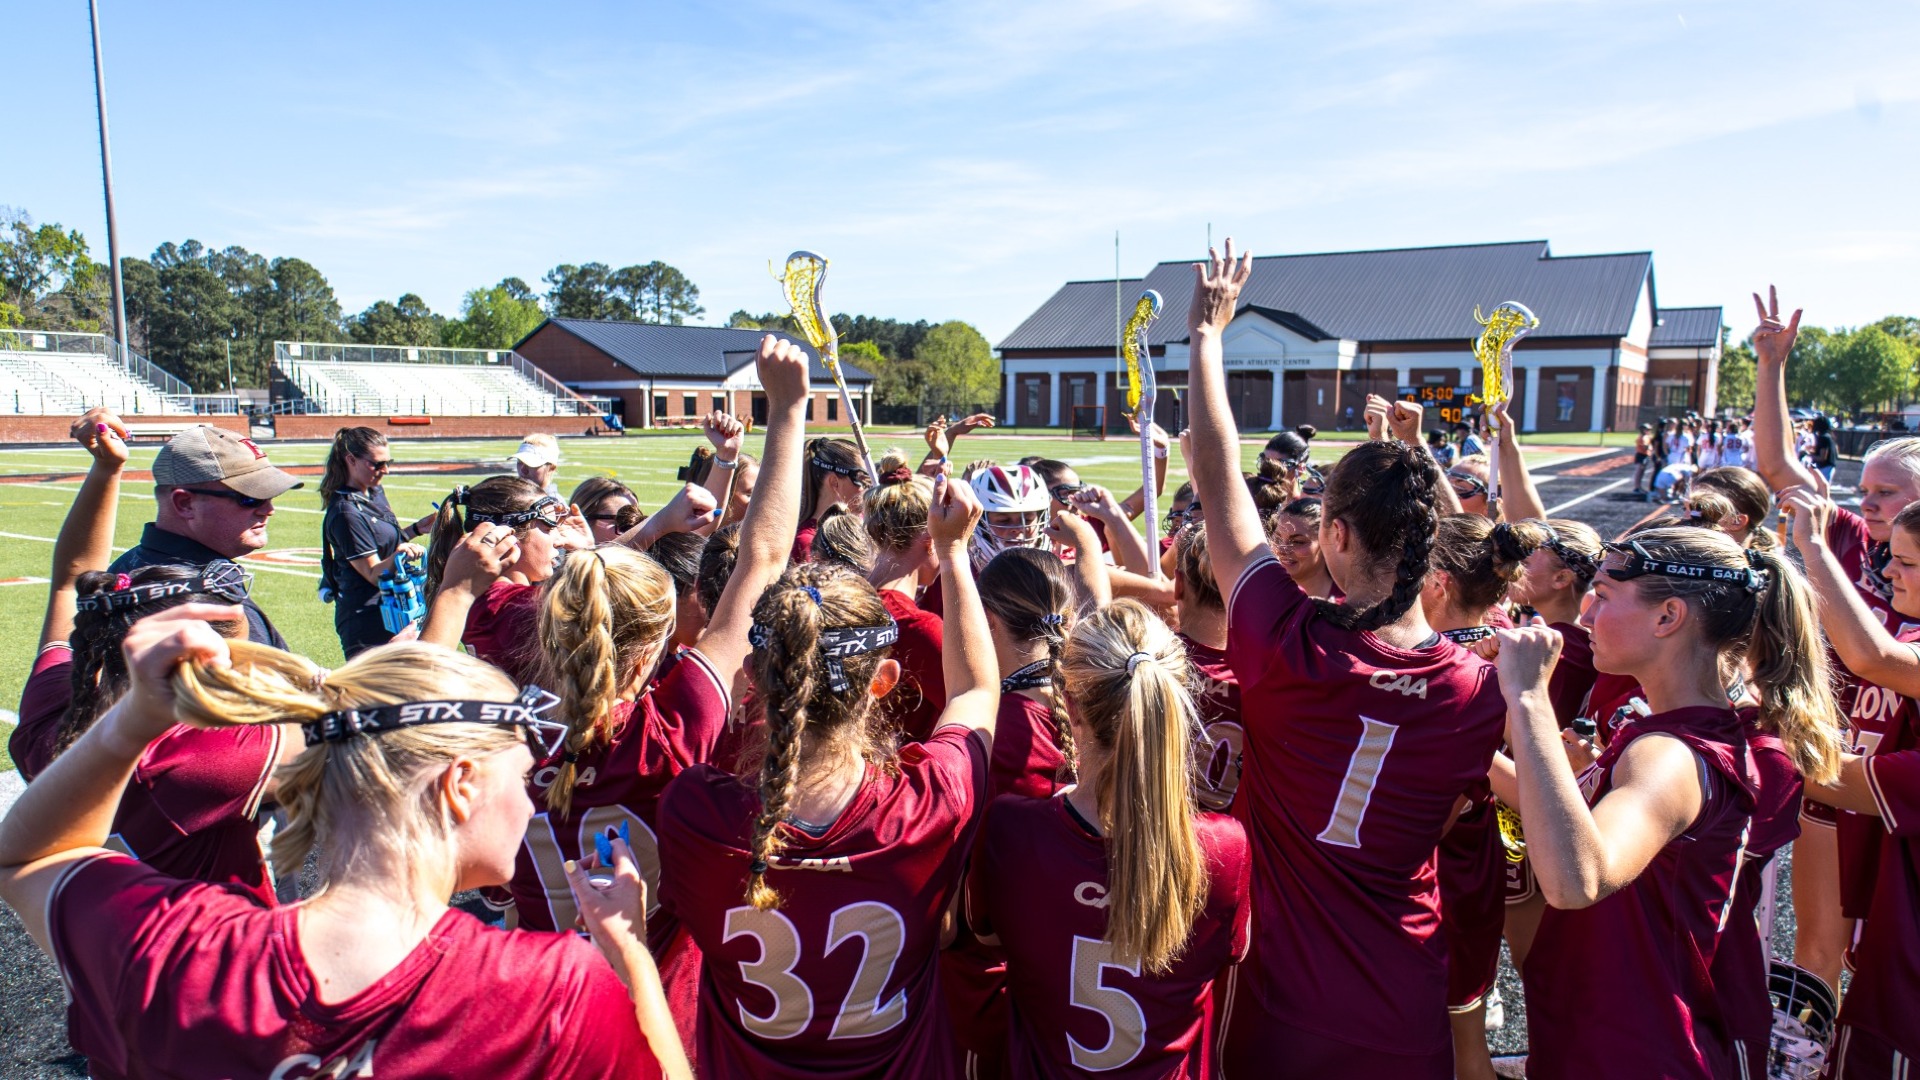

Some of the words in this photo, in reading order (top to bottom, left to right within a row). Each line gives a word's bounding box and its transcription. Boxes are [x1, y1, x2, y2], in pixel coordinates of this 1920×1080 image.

[1441, 408, 1461, 423] 90
[1666, 564, 1705, 576] GAIT
[1713, 569, 1746, 580] GAIT
[150, 582, 192, 600] STX
[824, 637, 867, 656] STX
[876, 628, 895, 647] STX
[1458, 632, 1483, 641] GAIT
[1369, 670, 1429, 700] CAA
[399, 702, 464, 723] STX
[479, 704, 534, 722] STX
[1850, 685, 1904, 722] LON
[533, 766, 597, 788] CA
[1315, 714, 1400, 850] 1
[722, 901, 907, 1040] 32
[1065, 934, 1147, 1073] 5
